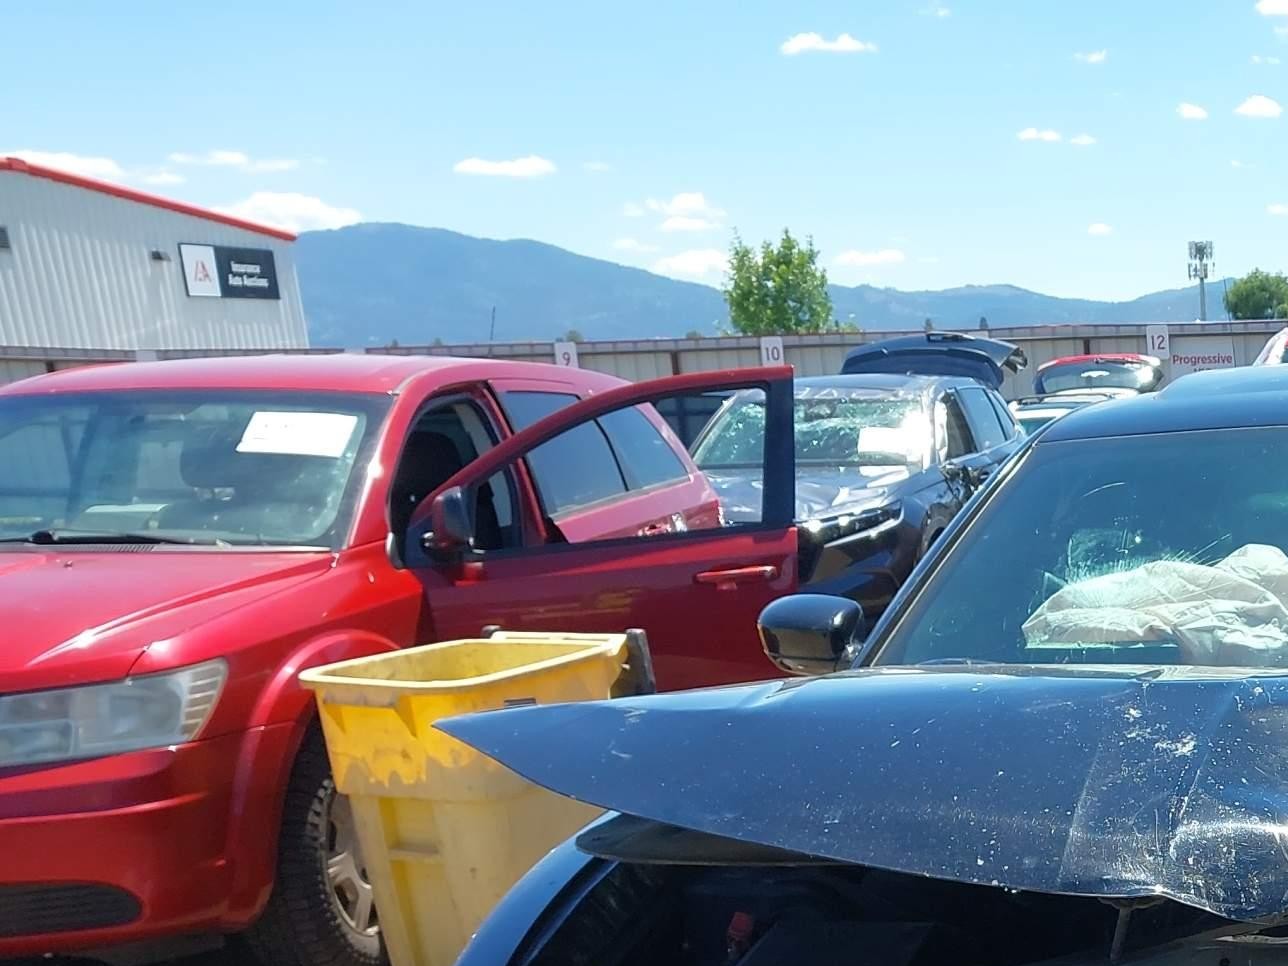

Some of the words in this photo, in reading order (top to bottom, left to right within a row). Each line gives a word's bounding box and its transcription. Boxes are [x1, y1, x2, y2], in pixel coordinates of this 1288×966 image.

[1151, 334, 1166, 350] 12
[562, 351, 571, 367] 9
[765, 346, 780, 361] 10
[1172, 353, 1233, 366] Progressive
